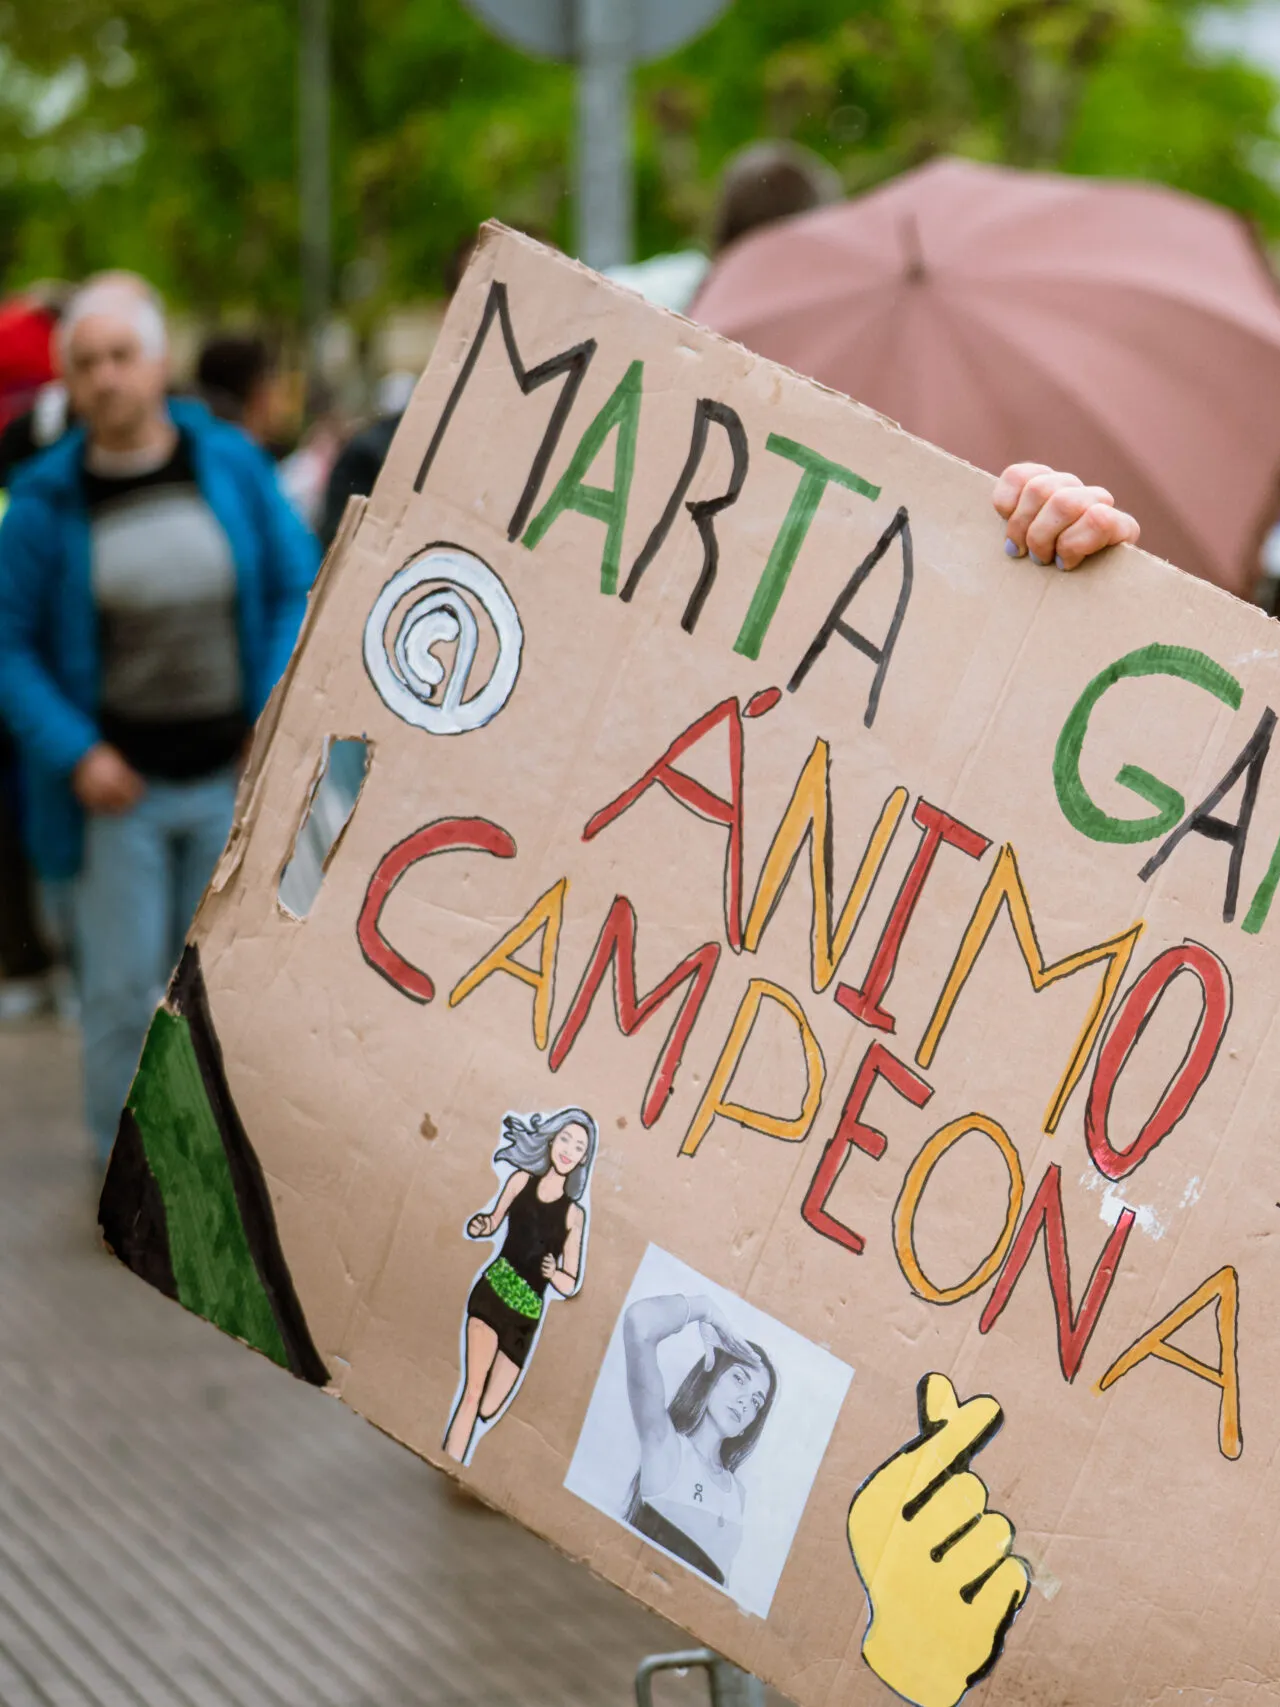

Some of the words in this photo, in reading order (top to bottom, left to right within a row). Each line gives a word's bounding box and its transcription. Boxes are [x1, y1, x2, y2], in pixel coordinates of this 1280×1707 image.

[414, 280, 914, 728] MARTA
[356, 815, 1242, 1460] CAMPEONA
[581, 686, 1232, 1180] ÁNIMO
